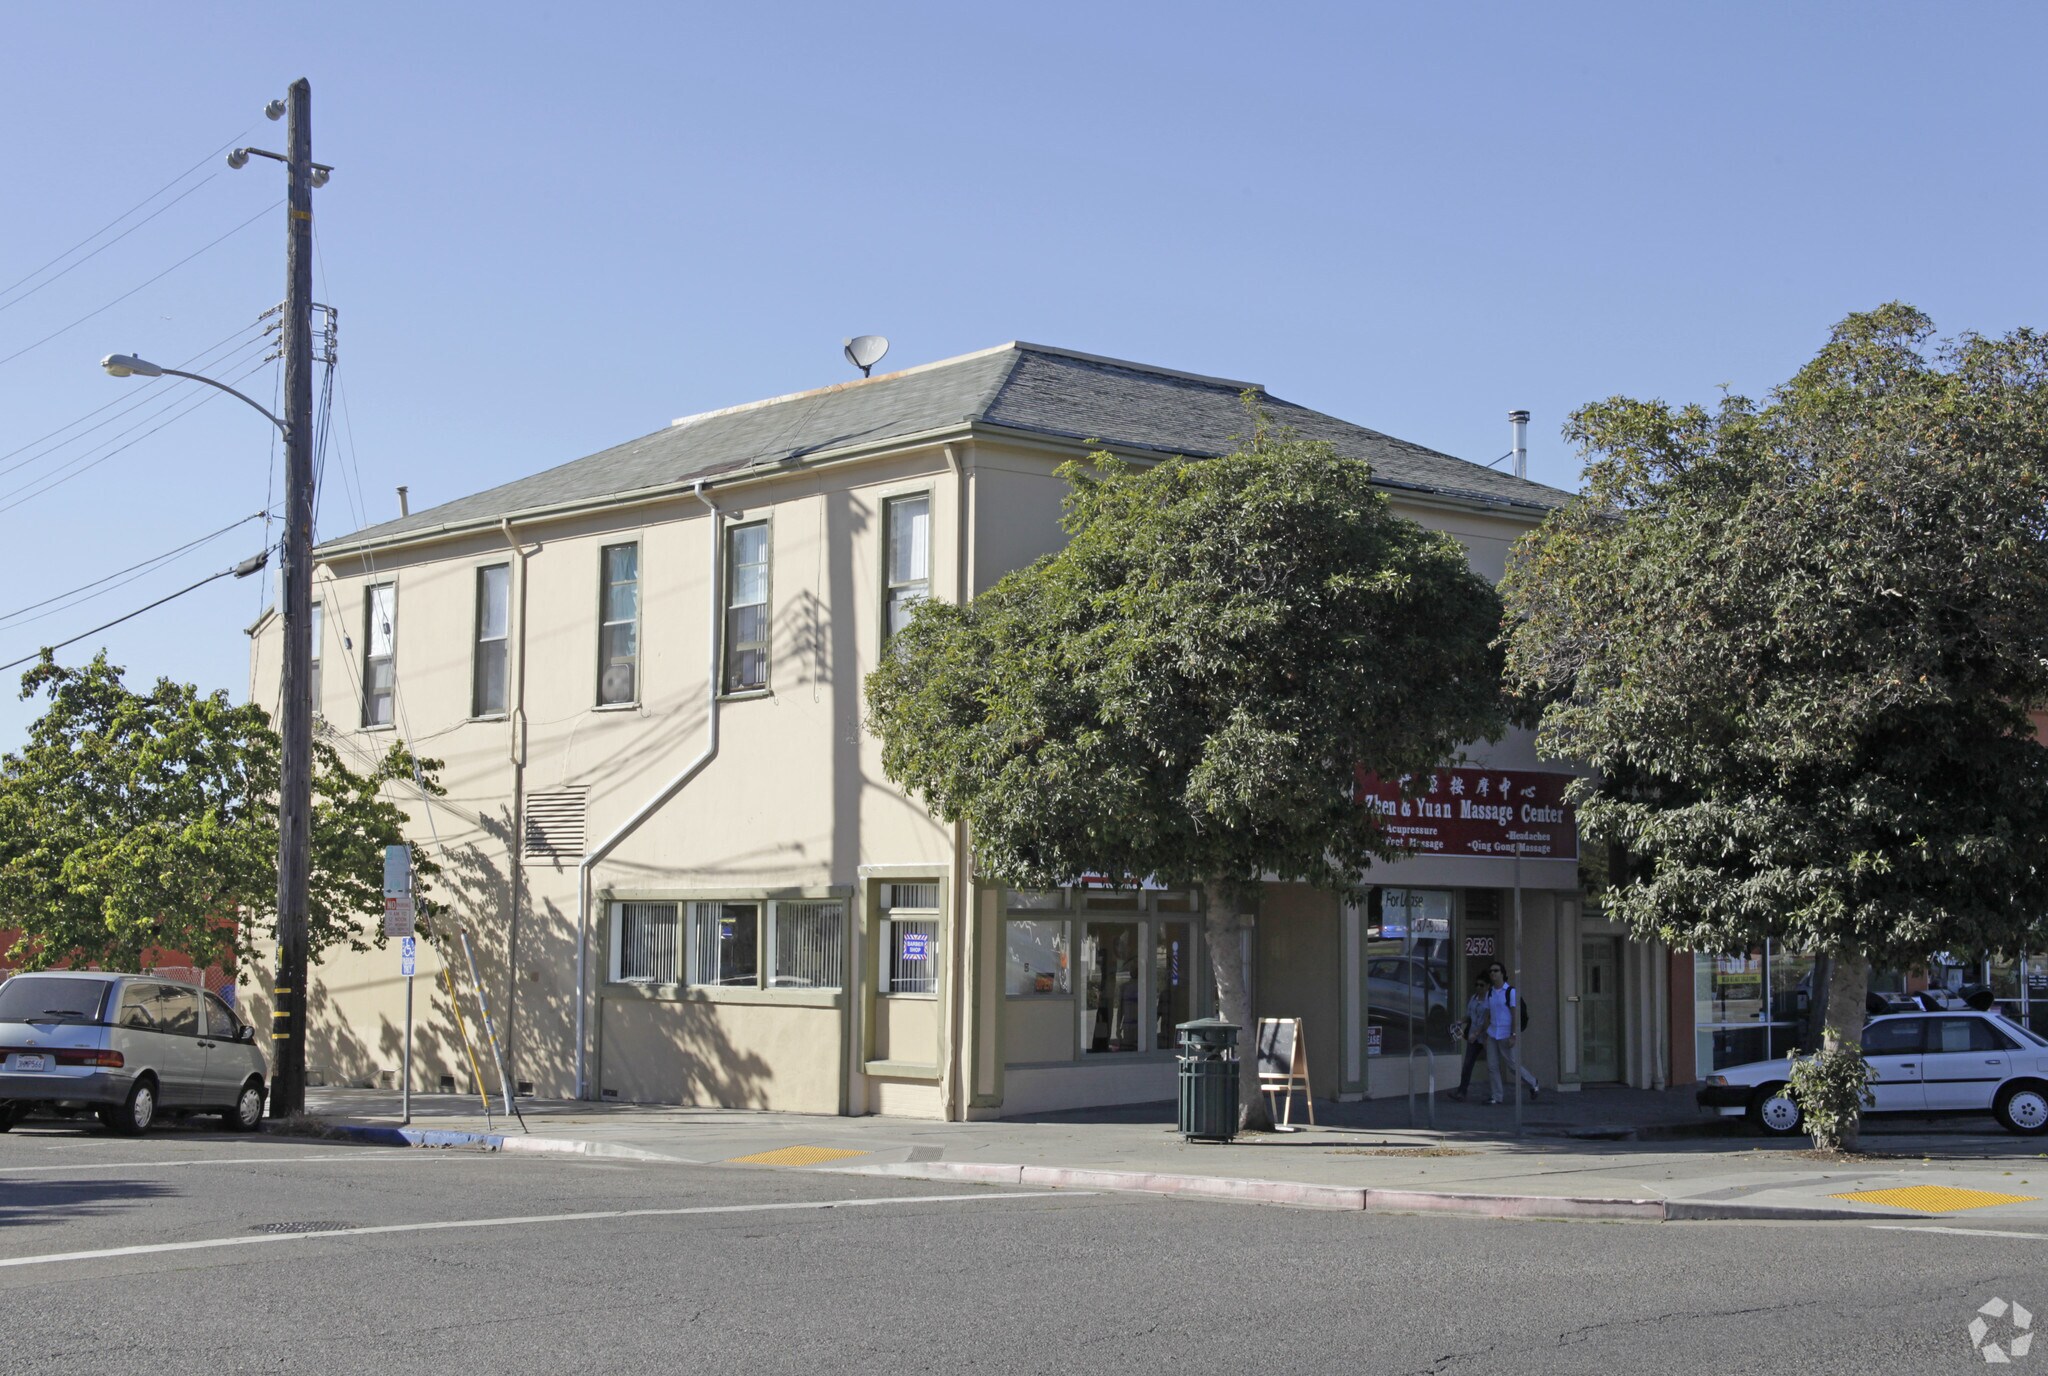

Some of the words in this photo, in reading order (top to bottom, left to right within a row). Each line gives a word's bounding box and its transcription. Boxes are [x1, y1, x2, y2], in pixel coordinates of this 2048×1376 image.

[1416, 797, 1452, 818] Yuan
[1460, 799, 1513, 826] Massage
[1521, 803, 1564, 823] Center
[1386, 824, 1438, 836] Acupressure
[1471, 840, 1492, 852] Qing
[1494, 841, 1516, 853] Gong
[386, 900, 396, 910] NO
[1386, 891, 1399, 908] For
[1464, 938, 1495, 957] 2528
